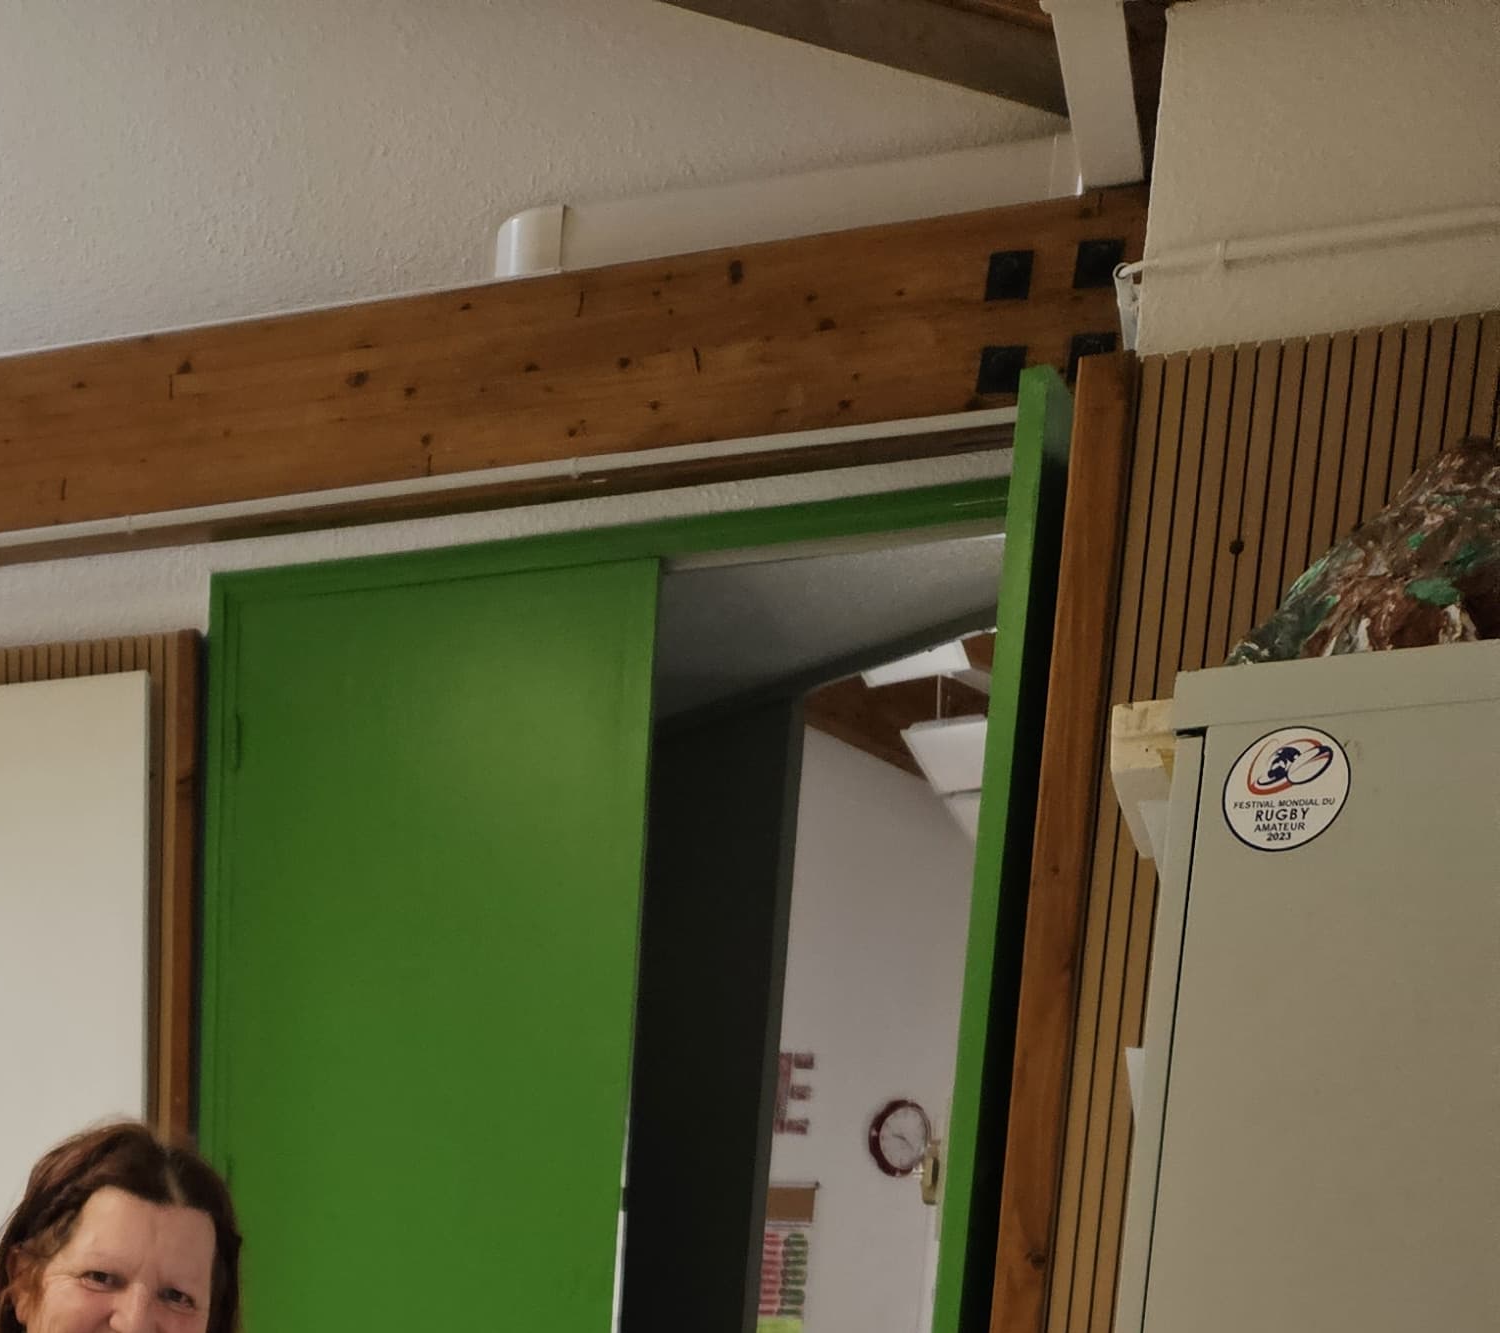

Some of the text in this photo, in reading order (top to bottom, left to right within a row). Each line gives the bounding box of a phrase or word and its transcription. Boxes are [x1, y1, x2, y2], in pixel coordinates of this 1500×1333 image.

[1233, 797, 1335, 808] FESTIVAL MONDIAL DU
[1255, 807, 1309, 821] RUGBY
[1254, 822, 1305, 832] AMATEUR
[1266, 832, 1291, 841] 2023
